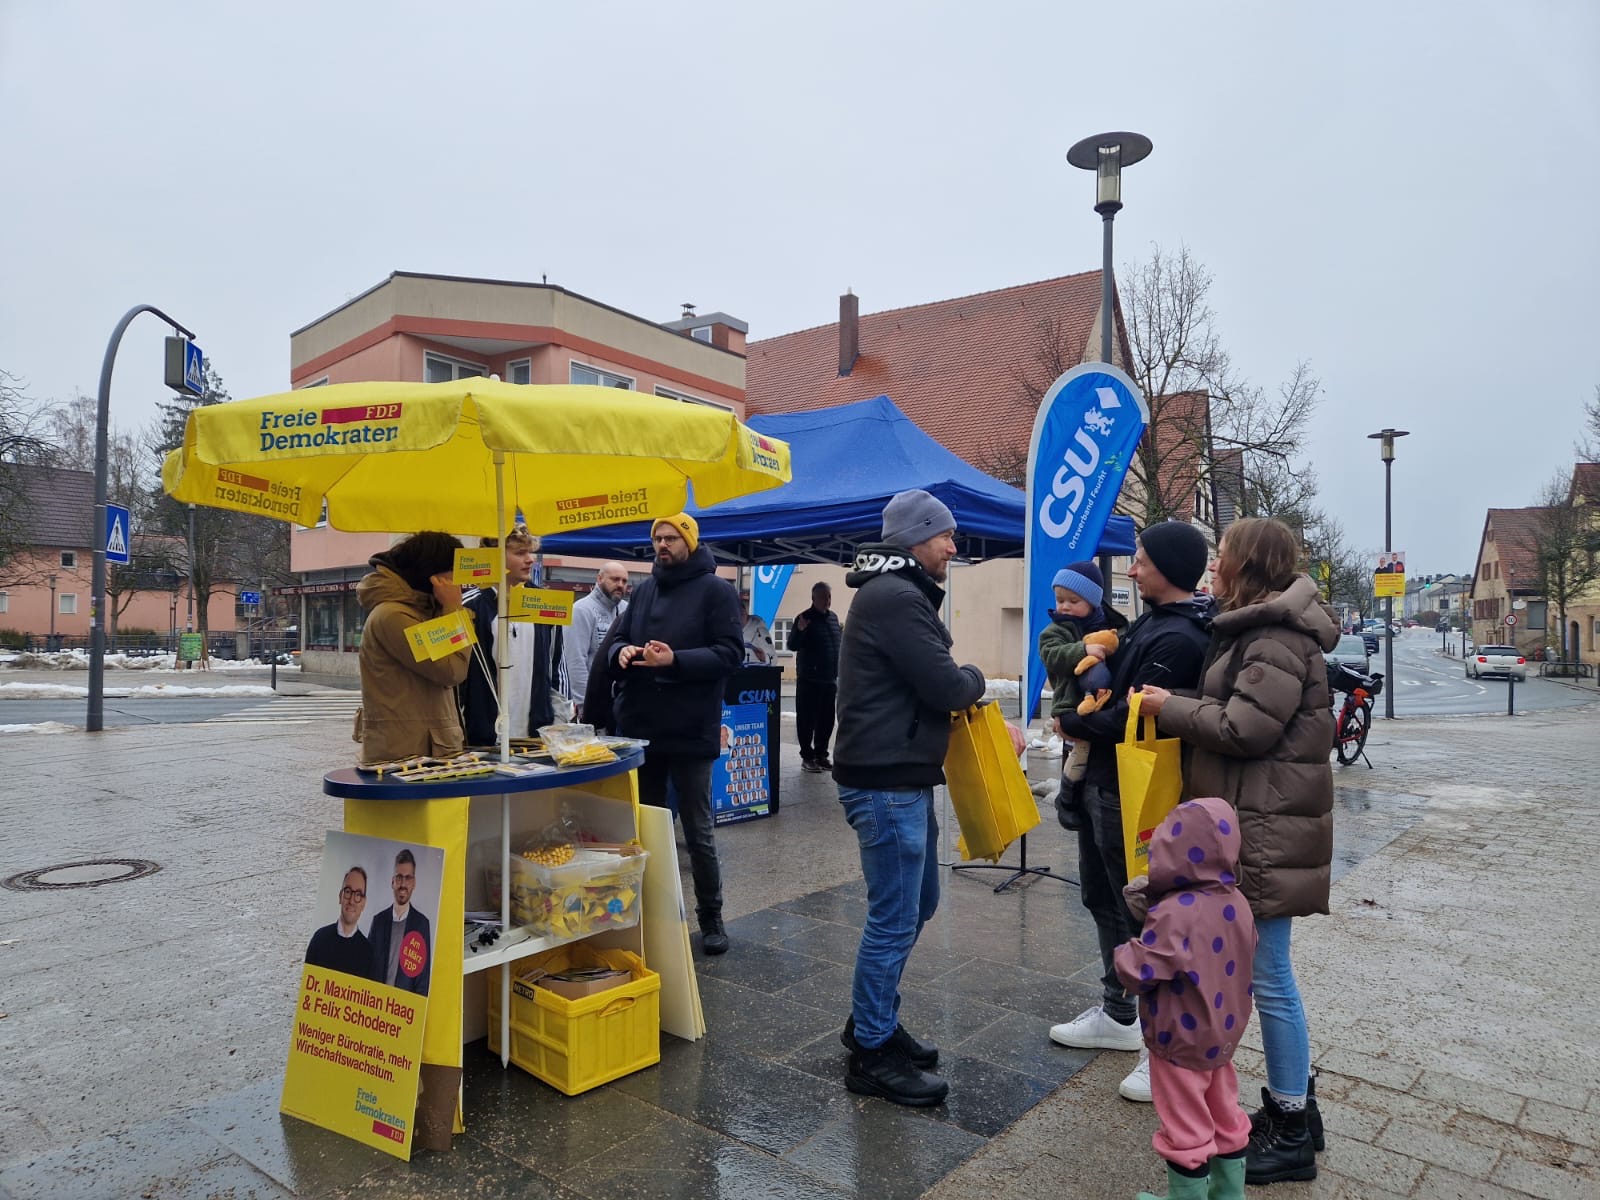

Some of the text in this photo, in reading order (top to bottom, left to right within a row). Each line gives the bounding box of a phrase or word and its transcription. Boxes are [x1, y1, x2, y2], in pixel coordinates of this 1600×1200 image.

[260, 404, 399, 430] Freie FDP
[259, 425, 398, 452] Demokraten
[1039, 427, 1100, 539] CSU
[1068, 470, 1108, 550] Ortsverband Feucht
[738, 689, 765, 704] CSU
[404, 959, 417, 972] FDP
[306, 975, 415, 1025] Dr. Maximilian Haag
[302, 994, 402, 1038] & Felix Schoderer
[296, 1038, 395, 1083] Wirtschaftswachstum.
[298, 1022, 412, 1071] Weniger Bürokratie, mehr
[357, 1087, 378, 1105] Freie
[355, 1100, 406, 1130] Demokraten
[391, 1129, 404, 1141] FDP
